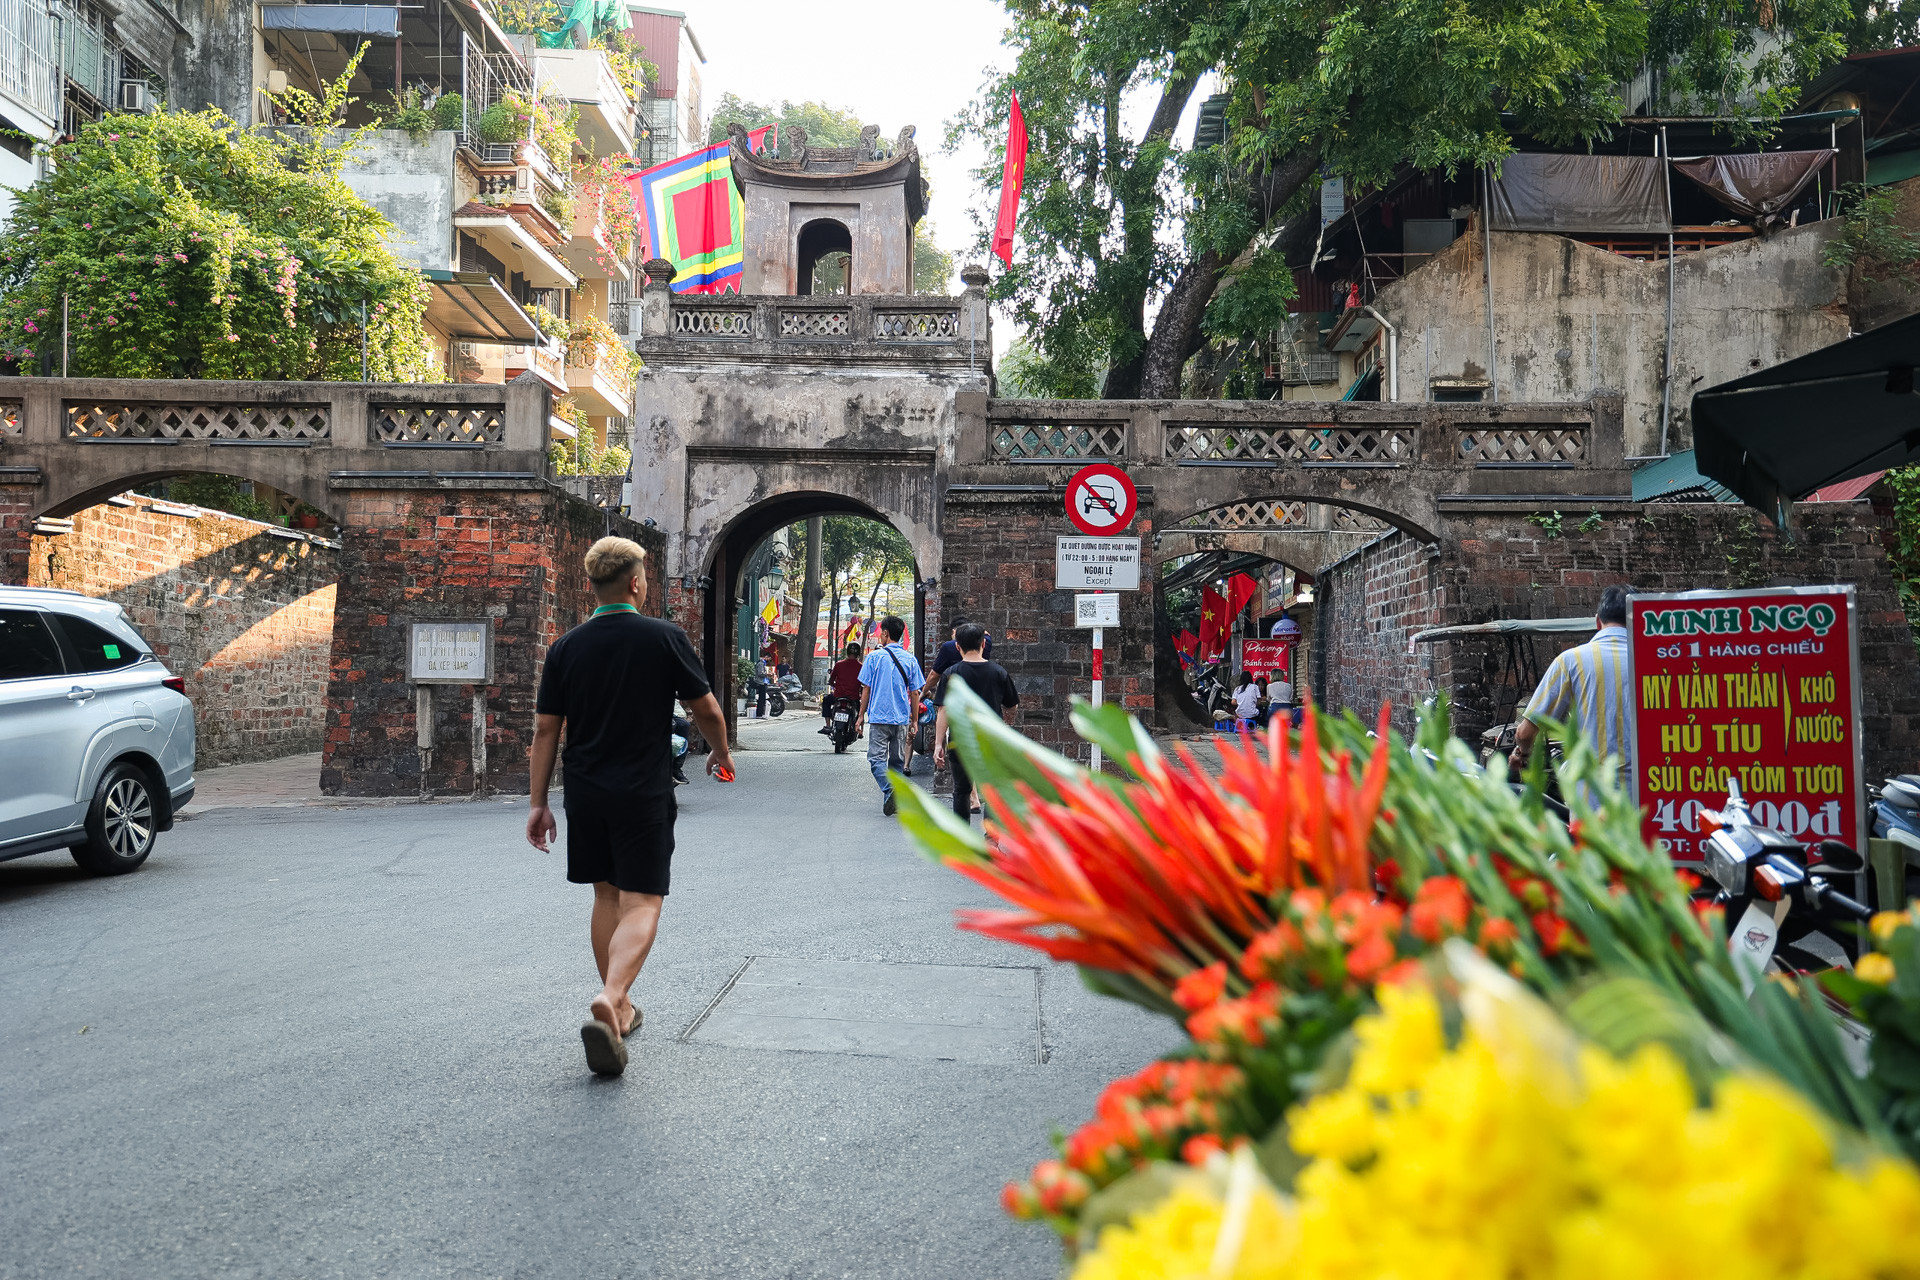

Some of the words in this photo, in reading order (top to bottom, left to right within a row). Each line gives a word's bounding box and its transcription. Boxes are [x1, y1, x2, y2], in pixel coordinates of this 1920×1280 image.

[1084, 566, 1104, 576] NGOẠI
[1106, 565, 1113, 576] LỆ
[1086, 577, 1111, 586] Except
[1643, 607, 1741, 636] MINH
[1749, 603, 1835, 636] NGỌ
[1243, 658, 1262, 666] Bánh
[1657, 643, 1682, 658] SỐ
[1687, 642, 1703, 658] 1
[1709, 642, 1761, 657] HÀNG
[1767, 638, 1824, 655] CHIẾU
[1642, 668, 1672, 710] MỲ
[1678, 661, 1718, 709] VẰN
[1724, 662, 1778, 708] THẮN
[1800, 671, 1836, 703] KHÔ
[1661, 714, 1702, 753] HỦ
[1712, 718, 1762, 753] TÍU
[1796, 709, 1844, 743] NƯỚC
[1648, 757, 1682, 792] SỦI
[1689, 757, 1732, 793] CẢO
[1738, 761, 1786, 793] TÔM
[1792, 764, 1844, 794] TƯƠI
